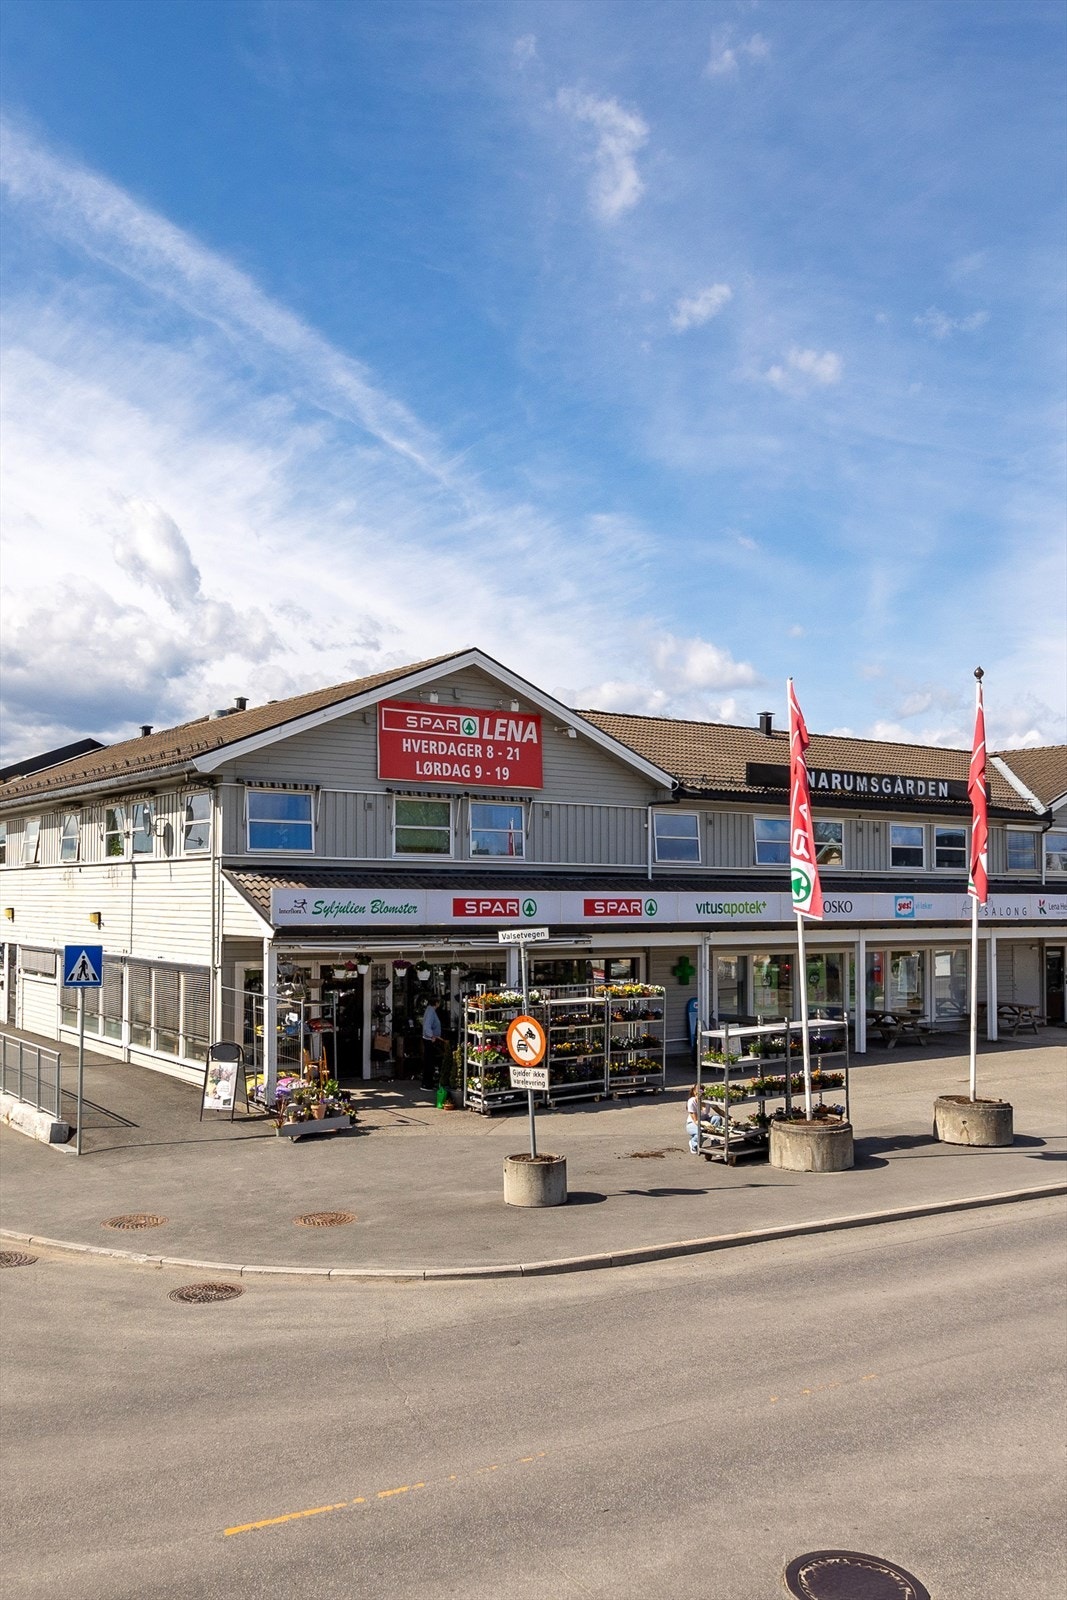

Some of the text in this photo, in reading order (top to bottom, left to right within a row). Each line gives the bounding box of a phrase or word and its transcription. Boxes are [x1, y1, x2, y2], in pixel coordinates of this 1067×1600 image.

[406, 715, 538, 744] SPAR LENA
[402, 738, 483, 758] HVERDAGER
[486, 745, 494, 759] 8
[506, 747, 520, 761] 21
[416, 760, 471, 778] LØRDAG
[475, 765, 482, 779] 9
[495, 767, 510, 780] 19
[806, 772, 949, 798] NARUMSGÅRDEN
[311, 899, 418, 918] Syljulien Blomster
[465, 901, 518, 914] SPAR
[594, 902, 641, 914] SPAR
[823, 900, 853, 913] OSKO
[984, 907, 1028, 916] SALONG
[501, 931, 545, 940] Valsetvegen
[533, 1070, 545, 1079] ikke
